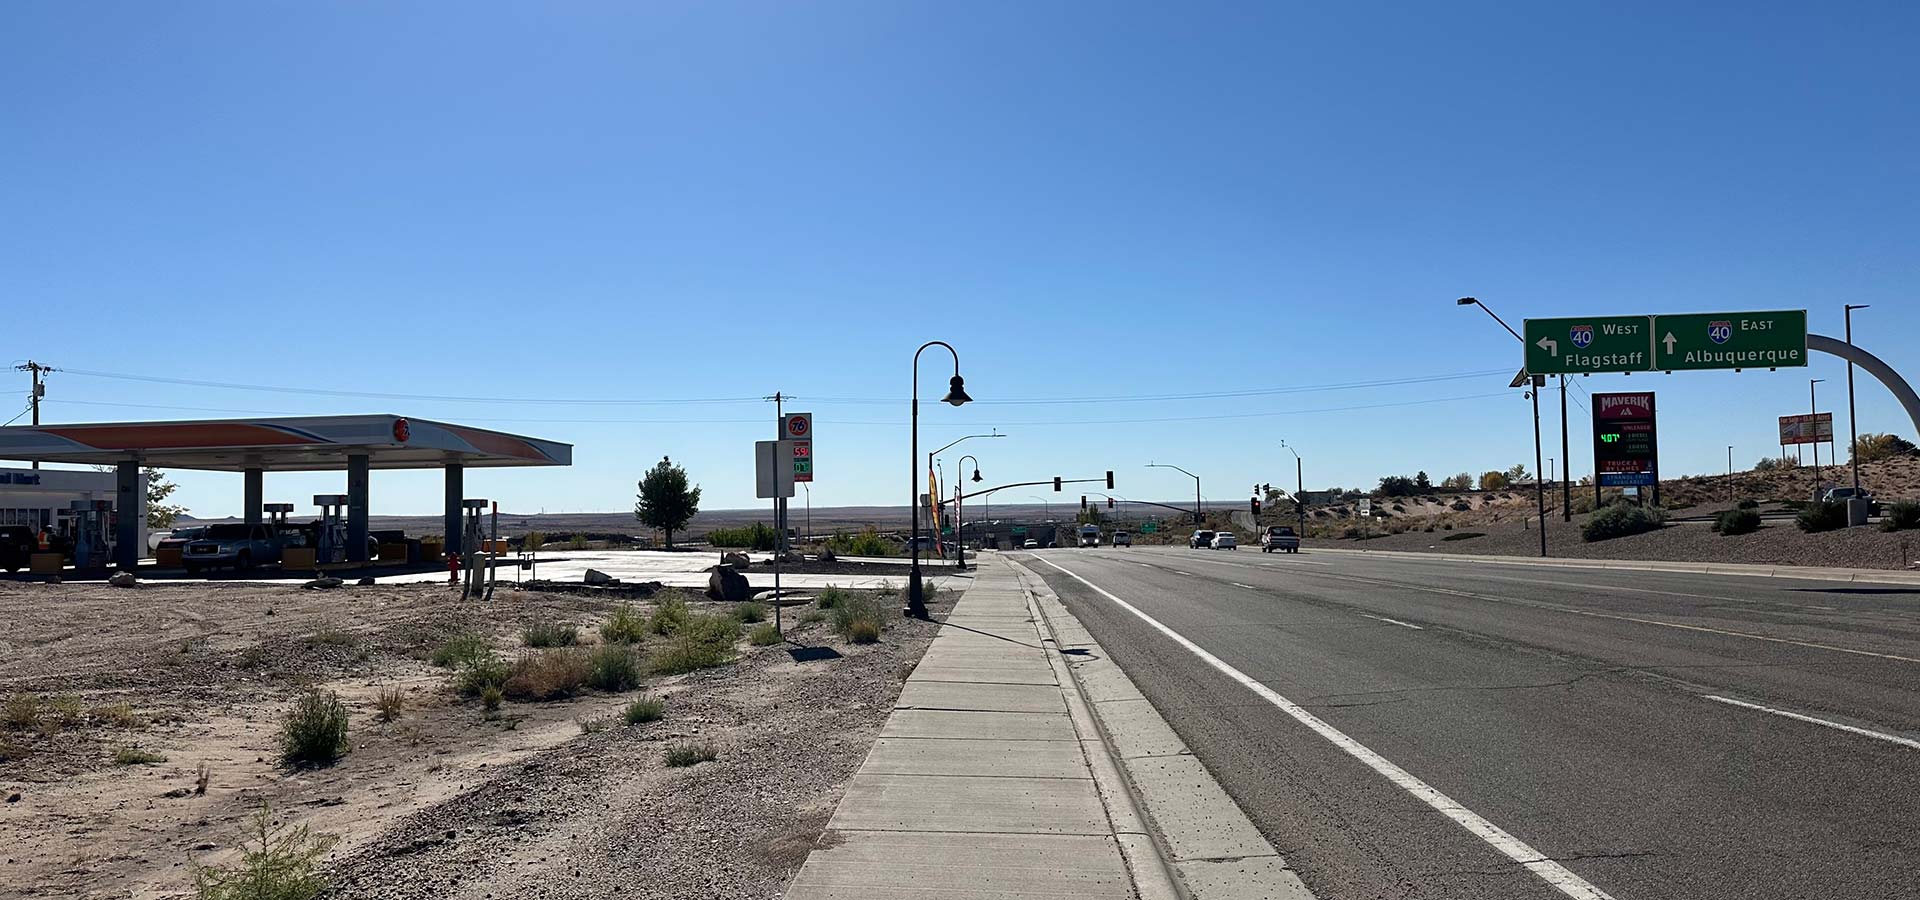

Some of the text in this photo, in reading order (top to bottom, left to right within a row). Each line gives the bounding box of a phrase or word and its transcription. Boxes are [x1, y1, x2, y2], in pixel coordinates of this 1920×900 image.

[1602, 324, 1639, 335] WEST
[1741, 319, 1774, 331] EAST
[1573, 331, 1592, 344] 40
[1711, 326, 1730, 340] 40
[1565, 352, 1643, 368] Flagstaff
[1685, 347, 1799, 365] Albuquerque
[1601, 396, 1650, 412] MAVERIK
[792, 421, 805, 432] 76
